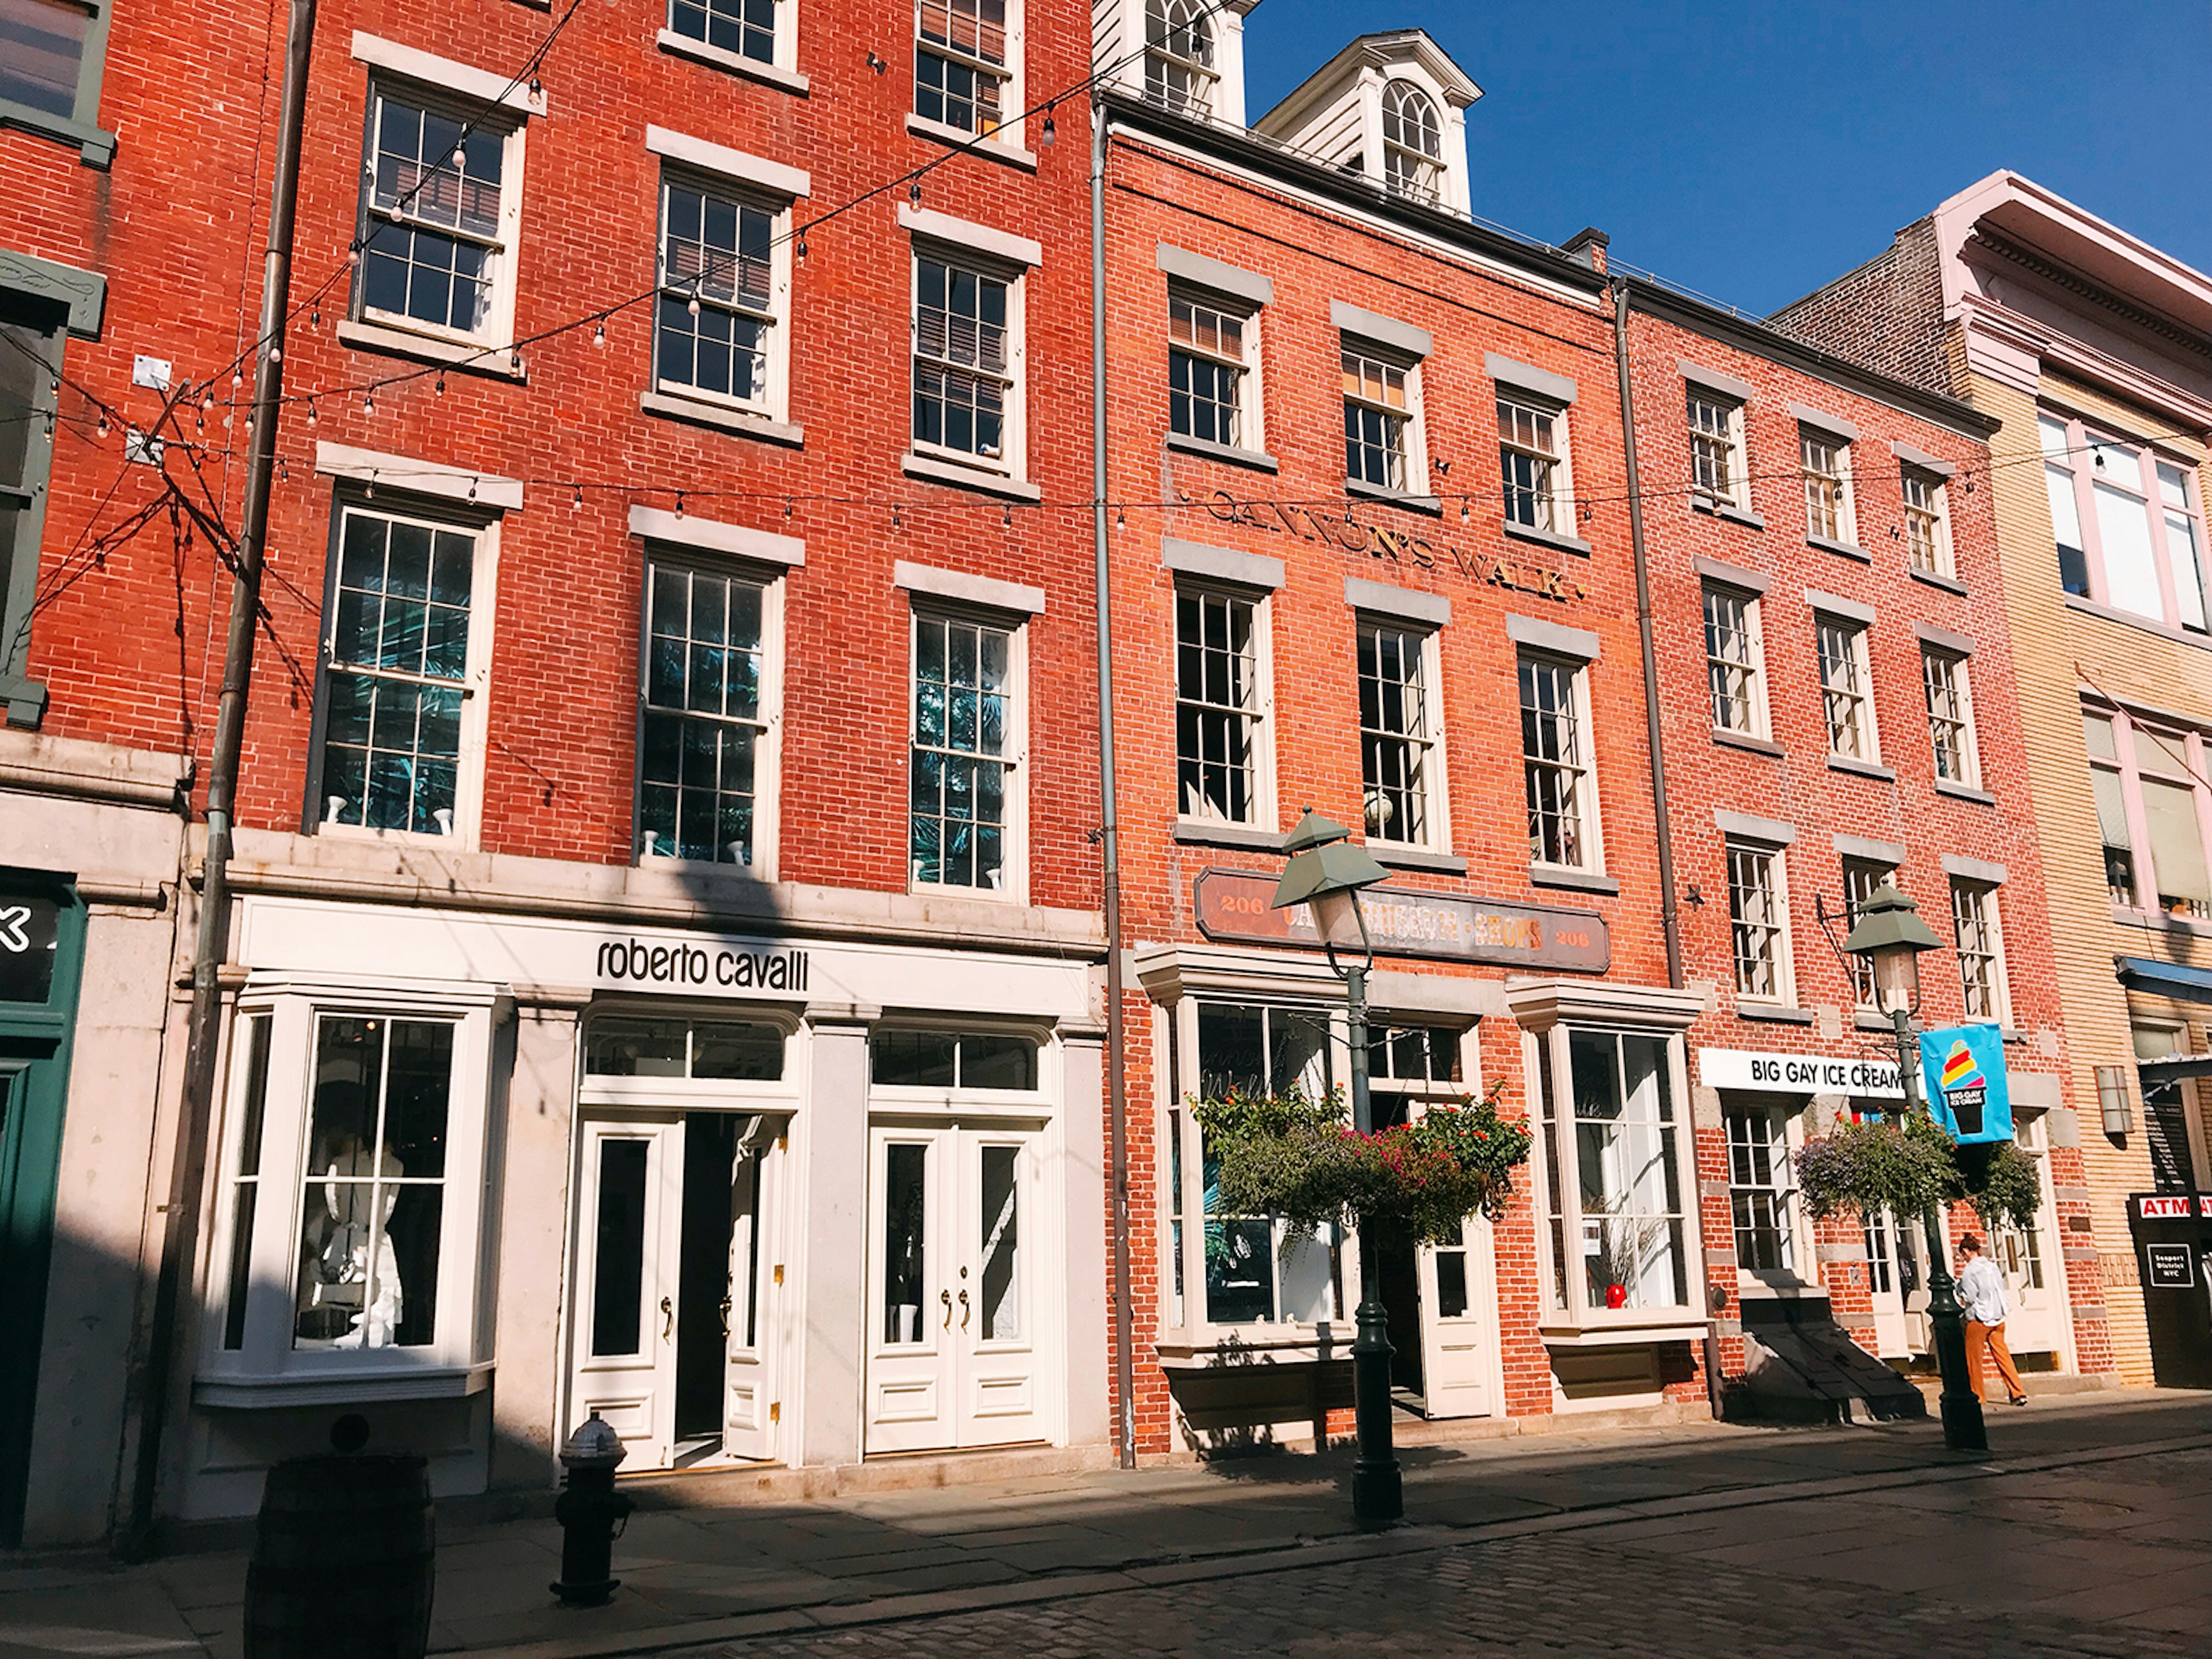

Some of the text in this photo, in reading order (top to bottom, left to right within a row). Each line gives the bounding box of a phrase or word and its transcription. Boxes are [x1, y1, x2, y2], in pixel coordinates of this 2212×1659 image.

[1205, 491, 1569, 603] CANNON'S WALK
[1220, 895, 1265, 915] 206
[1475, 912, 1543, 950] SHOPS
[1556, 930, 1590, 948] 206
[597, 938, 808, 992] roberto cavalli
[1751, 1060, 1781, 1082] BIG
[1786, 1062, 1818, 1084] GAY
[1823, 1065, 1847, 1085] ICE
[2143, 1199, 2191, 1215] ATM
[2200, 1199, 2212, 1214] AT
